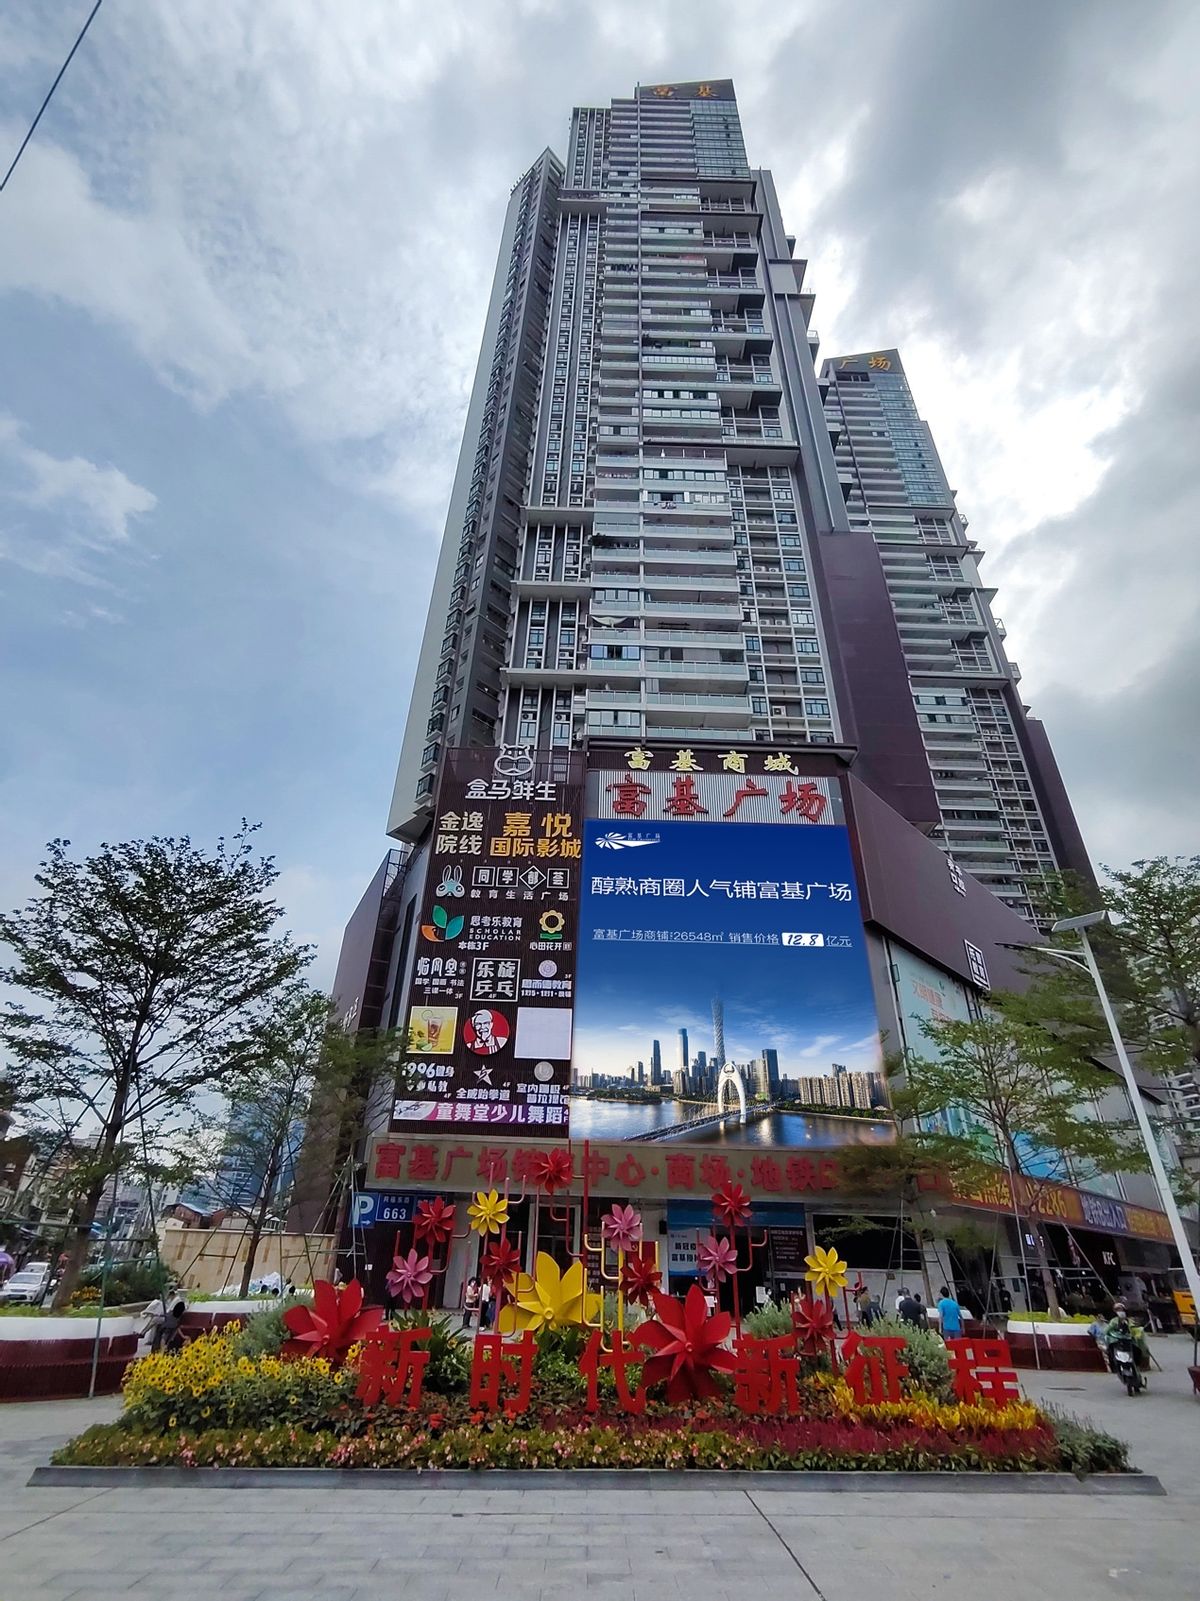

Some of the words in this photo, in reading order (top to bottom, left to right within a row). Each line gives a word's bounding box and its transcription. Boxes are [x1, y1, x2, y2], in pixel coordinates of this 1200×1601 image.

[838, 357, 891, 371] 广场
[624, 747, 800, 775] 富基商城
[465, 778, 557, 801] 盒马鲜生
[605, 771, 829, 822] 富基广场
[438, 811, 484, 832] 金逸
[502, 812, 573, 838] 嘉悦
[435, 834, 484, 856] 院线
[489, 837, 582, 859] 国际影城
[470, 888, 569, 902] 教育生活广场
[591, 876, 852, 902] 醇熟商圈人气铺富基广场
[469, 927, 521, 935] SCHOLAR
[470, 915, 523, 928] 思考乐教育
[529, 941, 563, 951] 心田花开
[728, 932, 779, 945] 销售价格
[787, 934, 819, 946] 12.8
[826, 935, 853, 947] 亿元
[474, 980, 515, 998] 乒乓
[436, 1102, 563, 1124] 童舞堂少儿舞蹈
[352, 1195, 374, 1225] P
[383, 1207, 407, 1220] 663
[355, 1325, 646, 1414] 新时代
[732, 1331, 1020, 1414] 新征程
